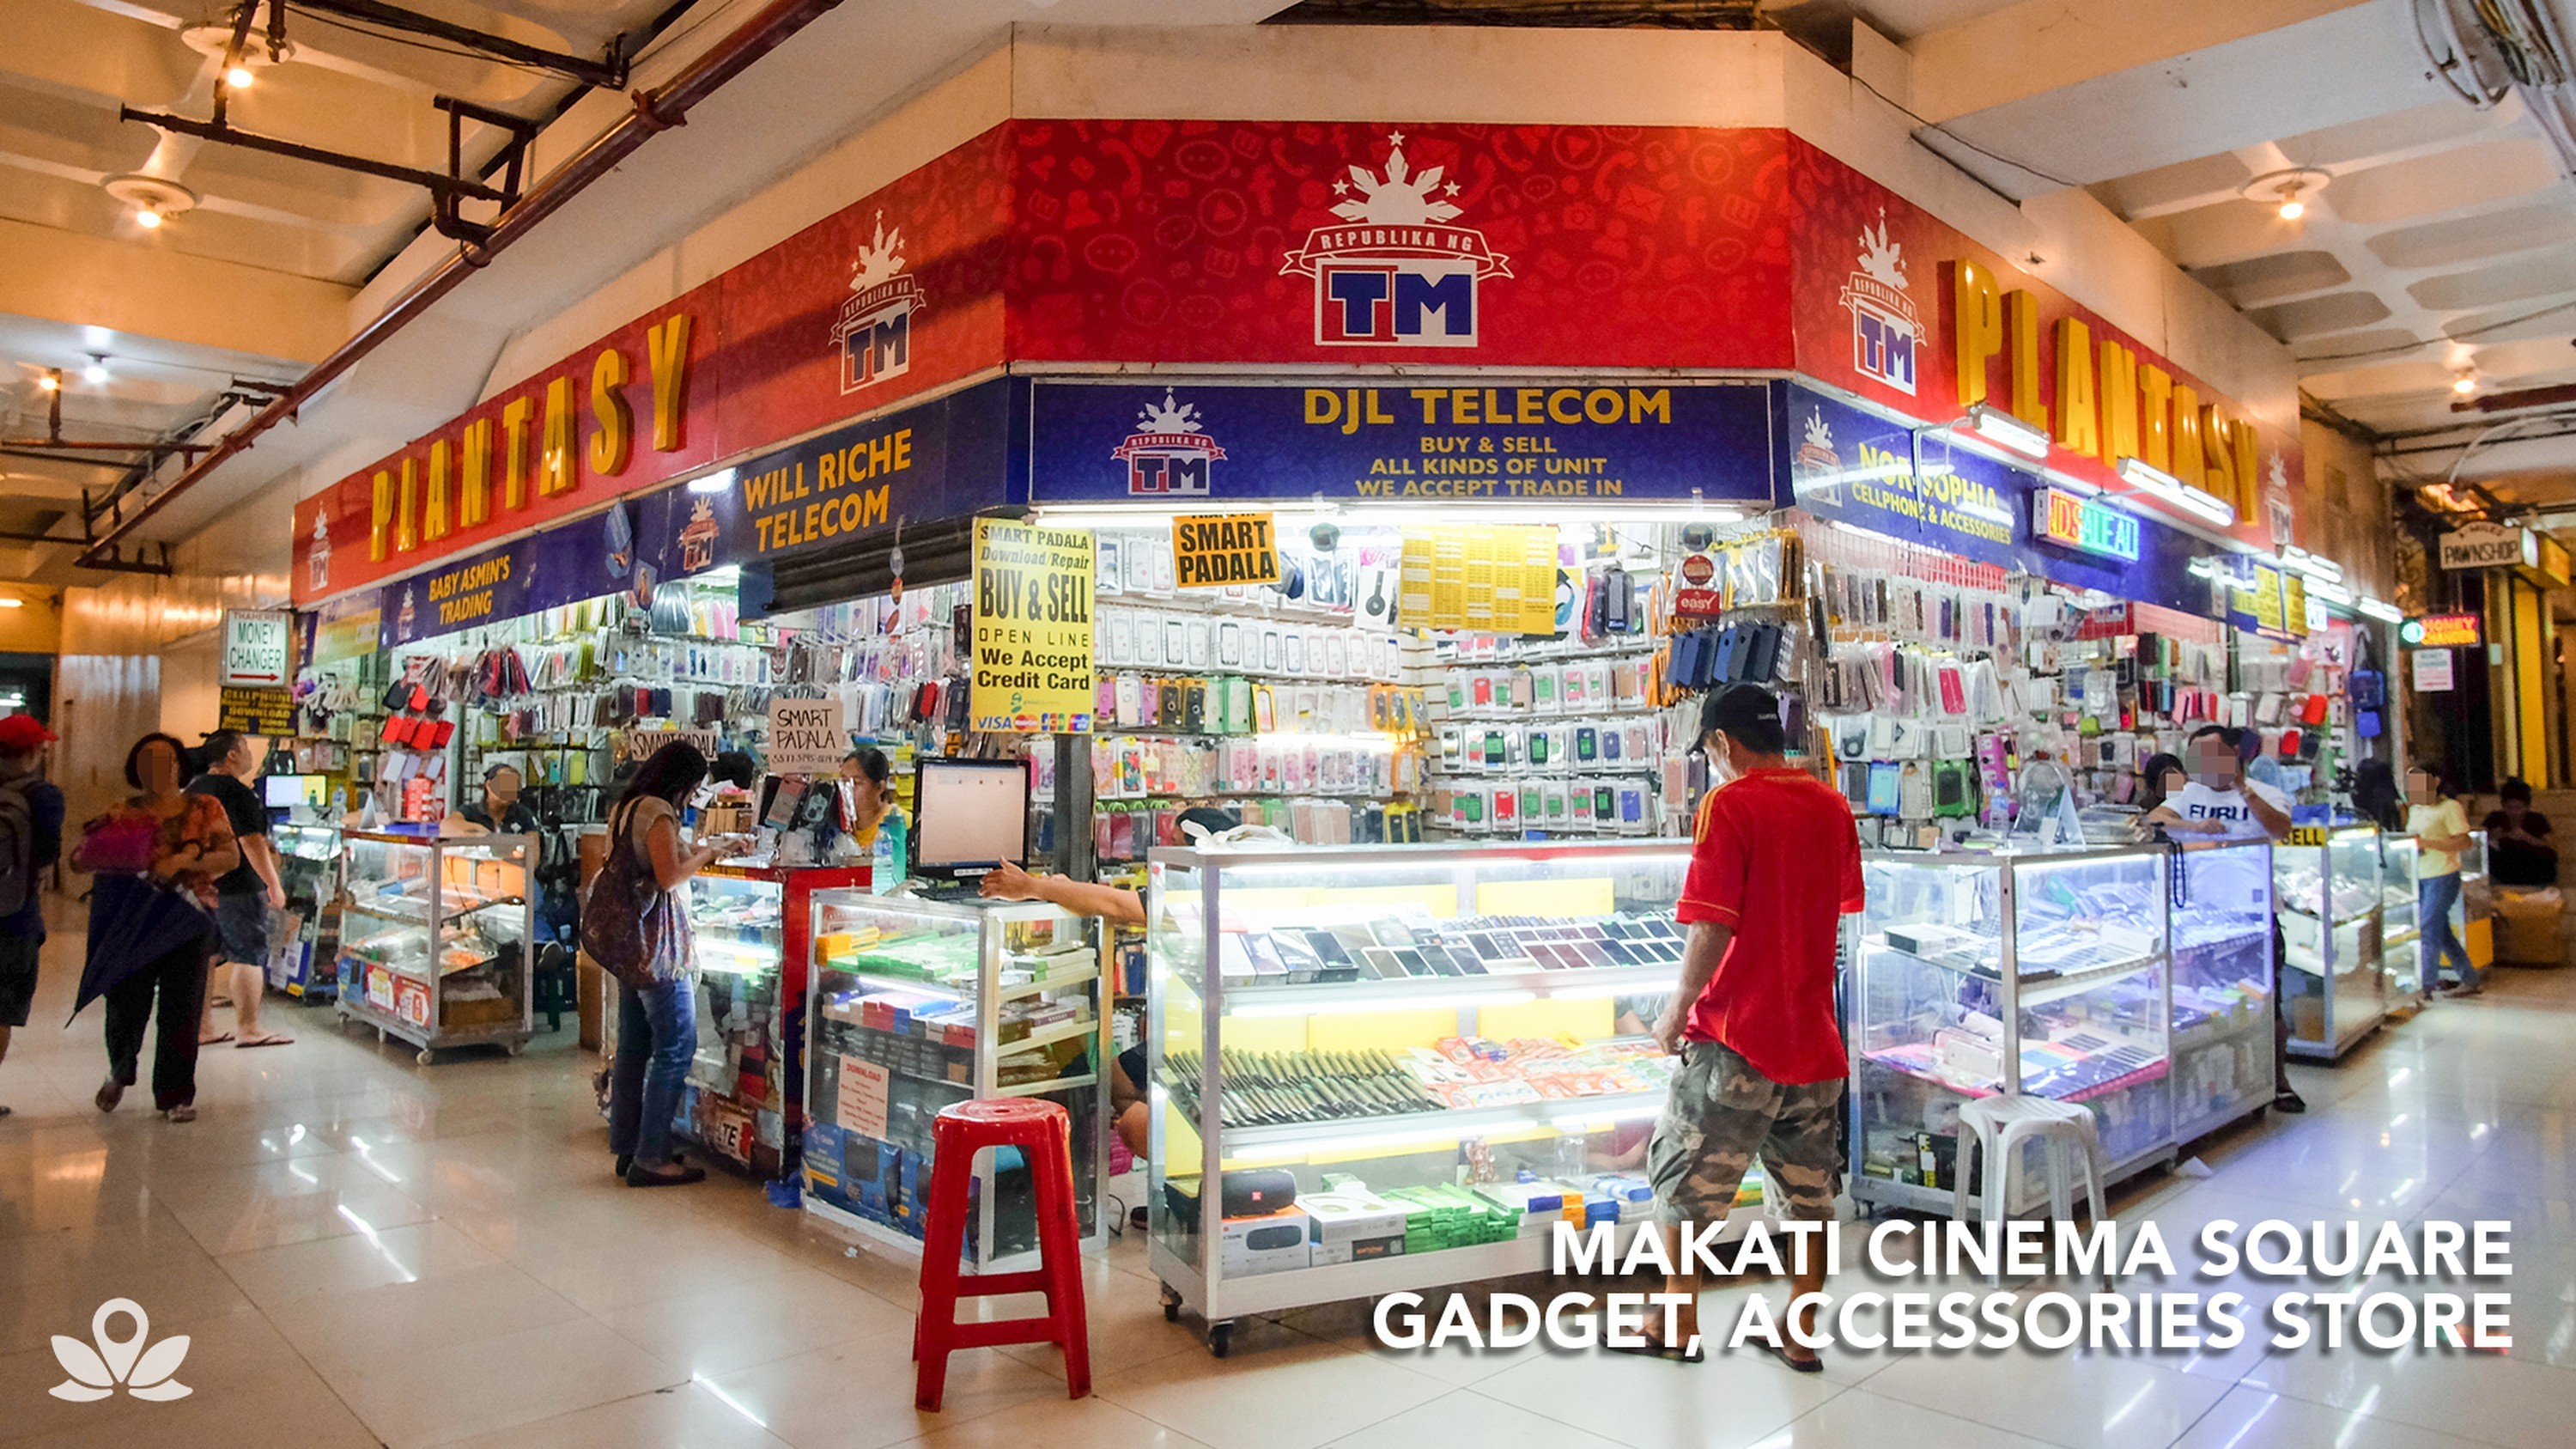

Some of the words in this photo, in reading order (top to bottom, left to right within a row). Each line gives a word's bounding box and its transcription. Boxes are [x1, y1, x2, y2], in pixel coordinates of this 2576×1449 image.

[1320, 229, 1437, 252] REPUBLIKA
[1447, 234, 1473, 253] NG
[844, 284, 894, 318] REPUBLIKA
[896, 279, 910, 296] NG
[1328, 272, 1473, 337] TM
[1854, 277, 1899, 312] REPUBLIKA
[1900, 301, 1915, 317] NG
[847, 312, 908, 382] TM
[1858, 310, 1914, 385] TM
[1954, 258, 2260, 527] PLANTASY
[1303, 388, 1394, 434] DJL
[1411, 388, 1672, 425] TELECOM
[369, 312, 692, 563] PLANTASY
[1130, 435, 1187, 449] REPUBLIKA
[1420, 436, 1473, 454] BUY
[1478, 436, 1494, 454] &
[1501, 436, 1558, 454] SELL
[743, 464, 809, 513] WILL
[817, 428, 913, 492] RICHE
[1134, 456, 1207, 491] TM
[1370, 458, 1418, 475] ALL
[1423, 458, 1500, 475] KINDS
[1505, 458, 1538, 475] OF
[1545, 458, 1608, 475] UNIT
[1355, 479, 1399, 496] WE
[1402, 479, 1492, 496] ACCEPT
[1498, 479, 1591, 496] TRADE
[1595, 479, 1623, 496] IN
[754, 484, 890, 553] TELECOM
[1852, 481, 1927, 521] CELLPHONE
[1928, 504, 1938, 525] &
[1940, 508, 2012, 545] ACCESSORIES
[980, 526, 1033, 545] SMART
[1037, 530, 1090, 551] PADALA
[1179, 520, 1267, 553] SMART
[2444, 540, 2518, 564] PAWNSHOP
[428, 569, 459, 602] BABY
[459, 554, 511, 594] ASMIN'S
[1178, 551, 1277, 583] PADALA
[439, 590, 493, 626] TRADING
[980, 568, 1023, 621] BUY
[1027, 579, 1042, 623] &
[1047, 573, 1088, 624] SELL
[237, 623, 276, 644] MONEY
[979, 628, 1032, 644] OPEN
[1048, 630, 1089, 648] LINE
[2421, 617, 2478, 631] MONEY
[229, 647, 283, 670] CHANGER
[980, 648, 1014, 667] We
[1020, 650, 1089, 672] Accept
[977, 670, 1041, 690] Credit
[1047, 673, 1091, 691] Card
[228, 707, 291, 719] DOWNLOAD
[776, 709, 833, 728] SMART
[977, 715, 1012, 730] VISA
[775, 729, 836, 751] PADALA
